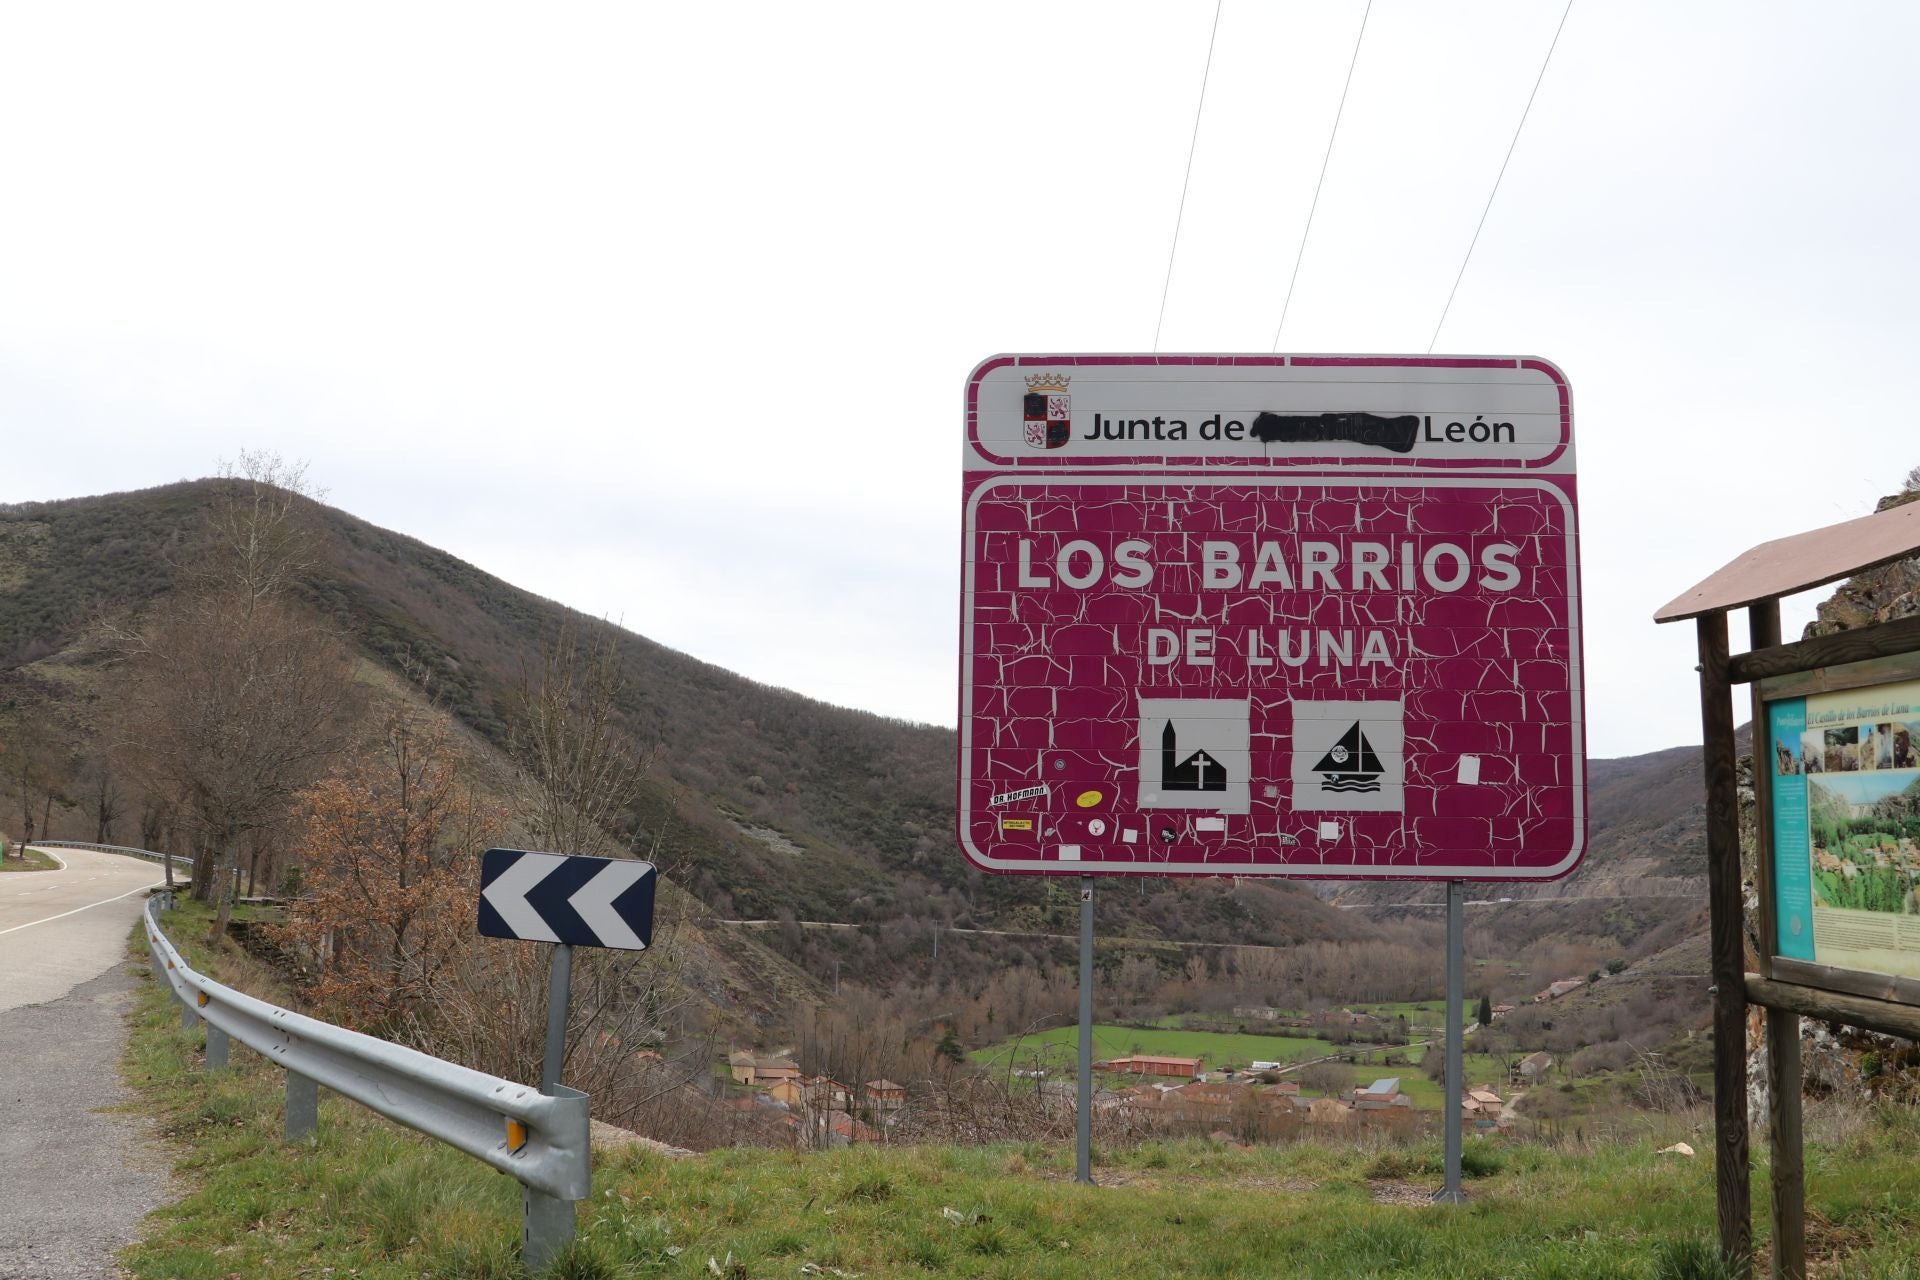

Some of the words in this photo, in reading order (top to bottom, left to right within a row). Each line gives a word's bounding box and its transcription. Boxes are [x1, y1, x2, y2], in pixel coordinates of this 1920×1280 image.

[1084, 413, 1187, 441] Junta
[1200, 414, 1245, 441] de
[1424, 415, 1515, 443] León
[1018, 539, 1154, 590] LOS
[1203, 540, 1521, 593] BARRIOS
[1147, 629, 1214, 665] DE
[1249, 629, 1394, 667] LUNA
[1890, 703, 1909, 716] Luna
